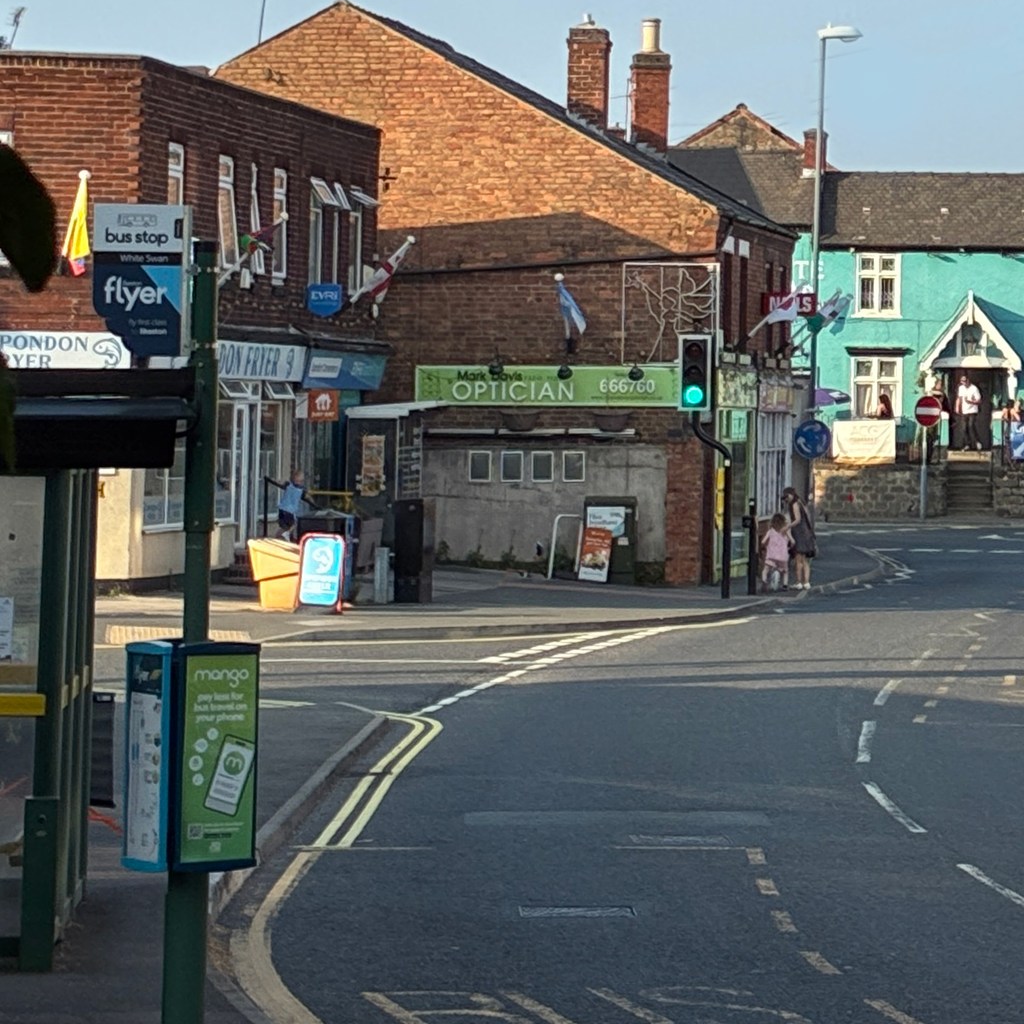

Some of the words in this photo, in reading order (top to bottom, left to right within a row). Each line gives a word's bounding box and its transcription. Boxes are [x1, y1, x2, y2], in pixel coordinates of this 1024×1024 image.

[105, 227, 132, 244] bus
[135, 230, 169, 247] stop
[120, 255, 144, 263] White
[146, 255, 168, 263] Swan
[104, 276, 168, 311] flyer
[769, 296, 812, 313] NLS
[0, 334, 88, 352] PONDON
[8, 353, 51, 368] YER
[244, 346, 281, 377] FRYER
[457, 370, 486, 382] Mark
[452, 381, 574, 401] OPTICIAN
[600, 379, 655, 394] 666760
[194, 668, 249, 688] mango
